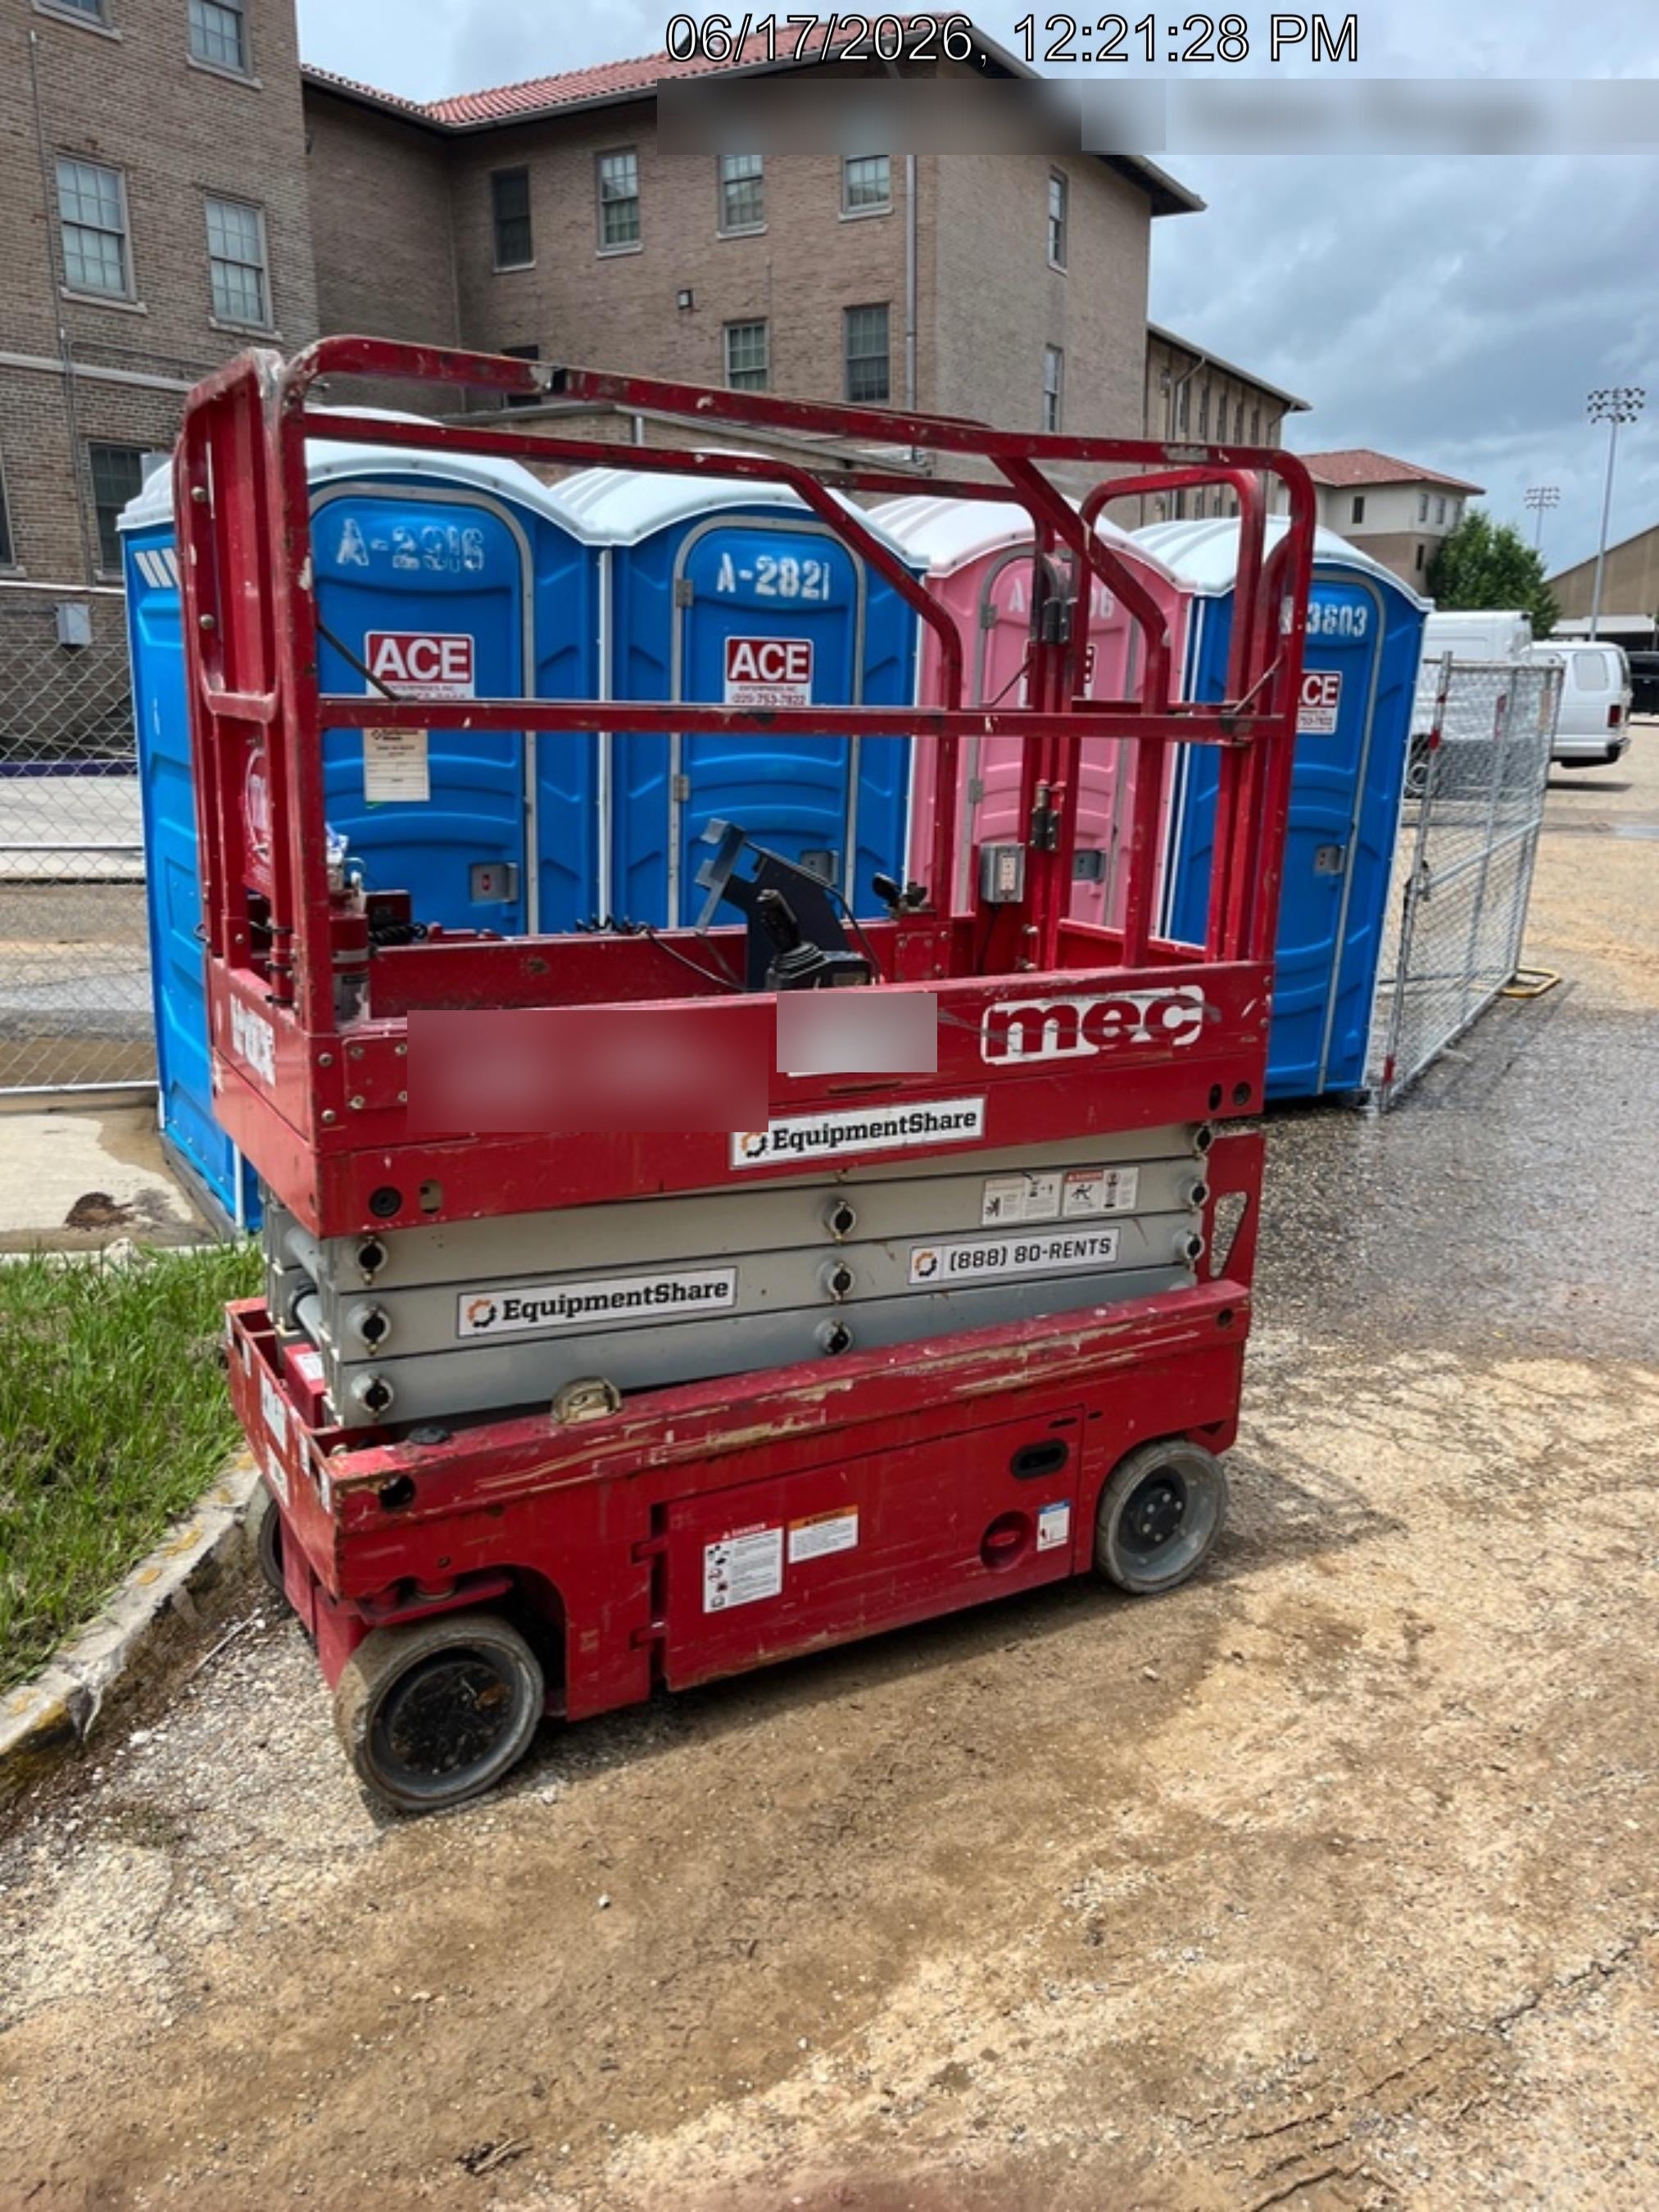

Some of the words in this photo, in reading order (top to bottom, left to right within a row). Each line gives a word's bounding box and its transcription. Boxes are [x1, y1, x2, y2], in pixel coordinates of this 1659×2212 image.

[717, 552, 830, 601] A-2821
[373, 638, 469, 680] ACE
[729, 643, 809, 681] ACE
[1299, 674, 1339, 706] CE
[986, 994, 1203, 1057] mec
[772, 1112, 977, 1152] EquipmentShare
[950, 1246, 1007, 1271] (888)
[501, 1281, 729, 1322] EquipmentShare
